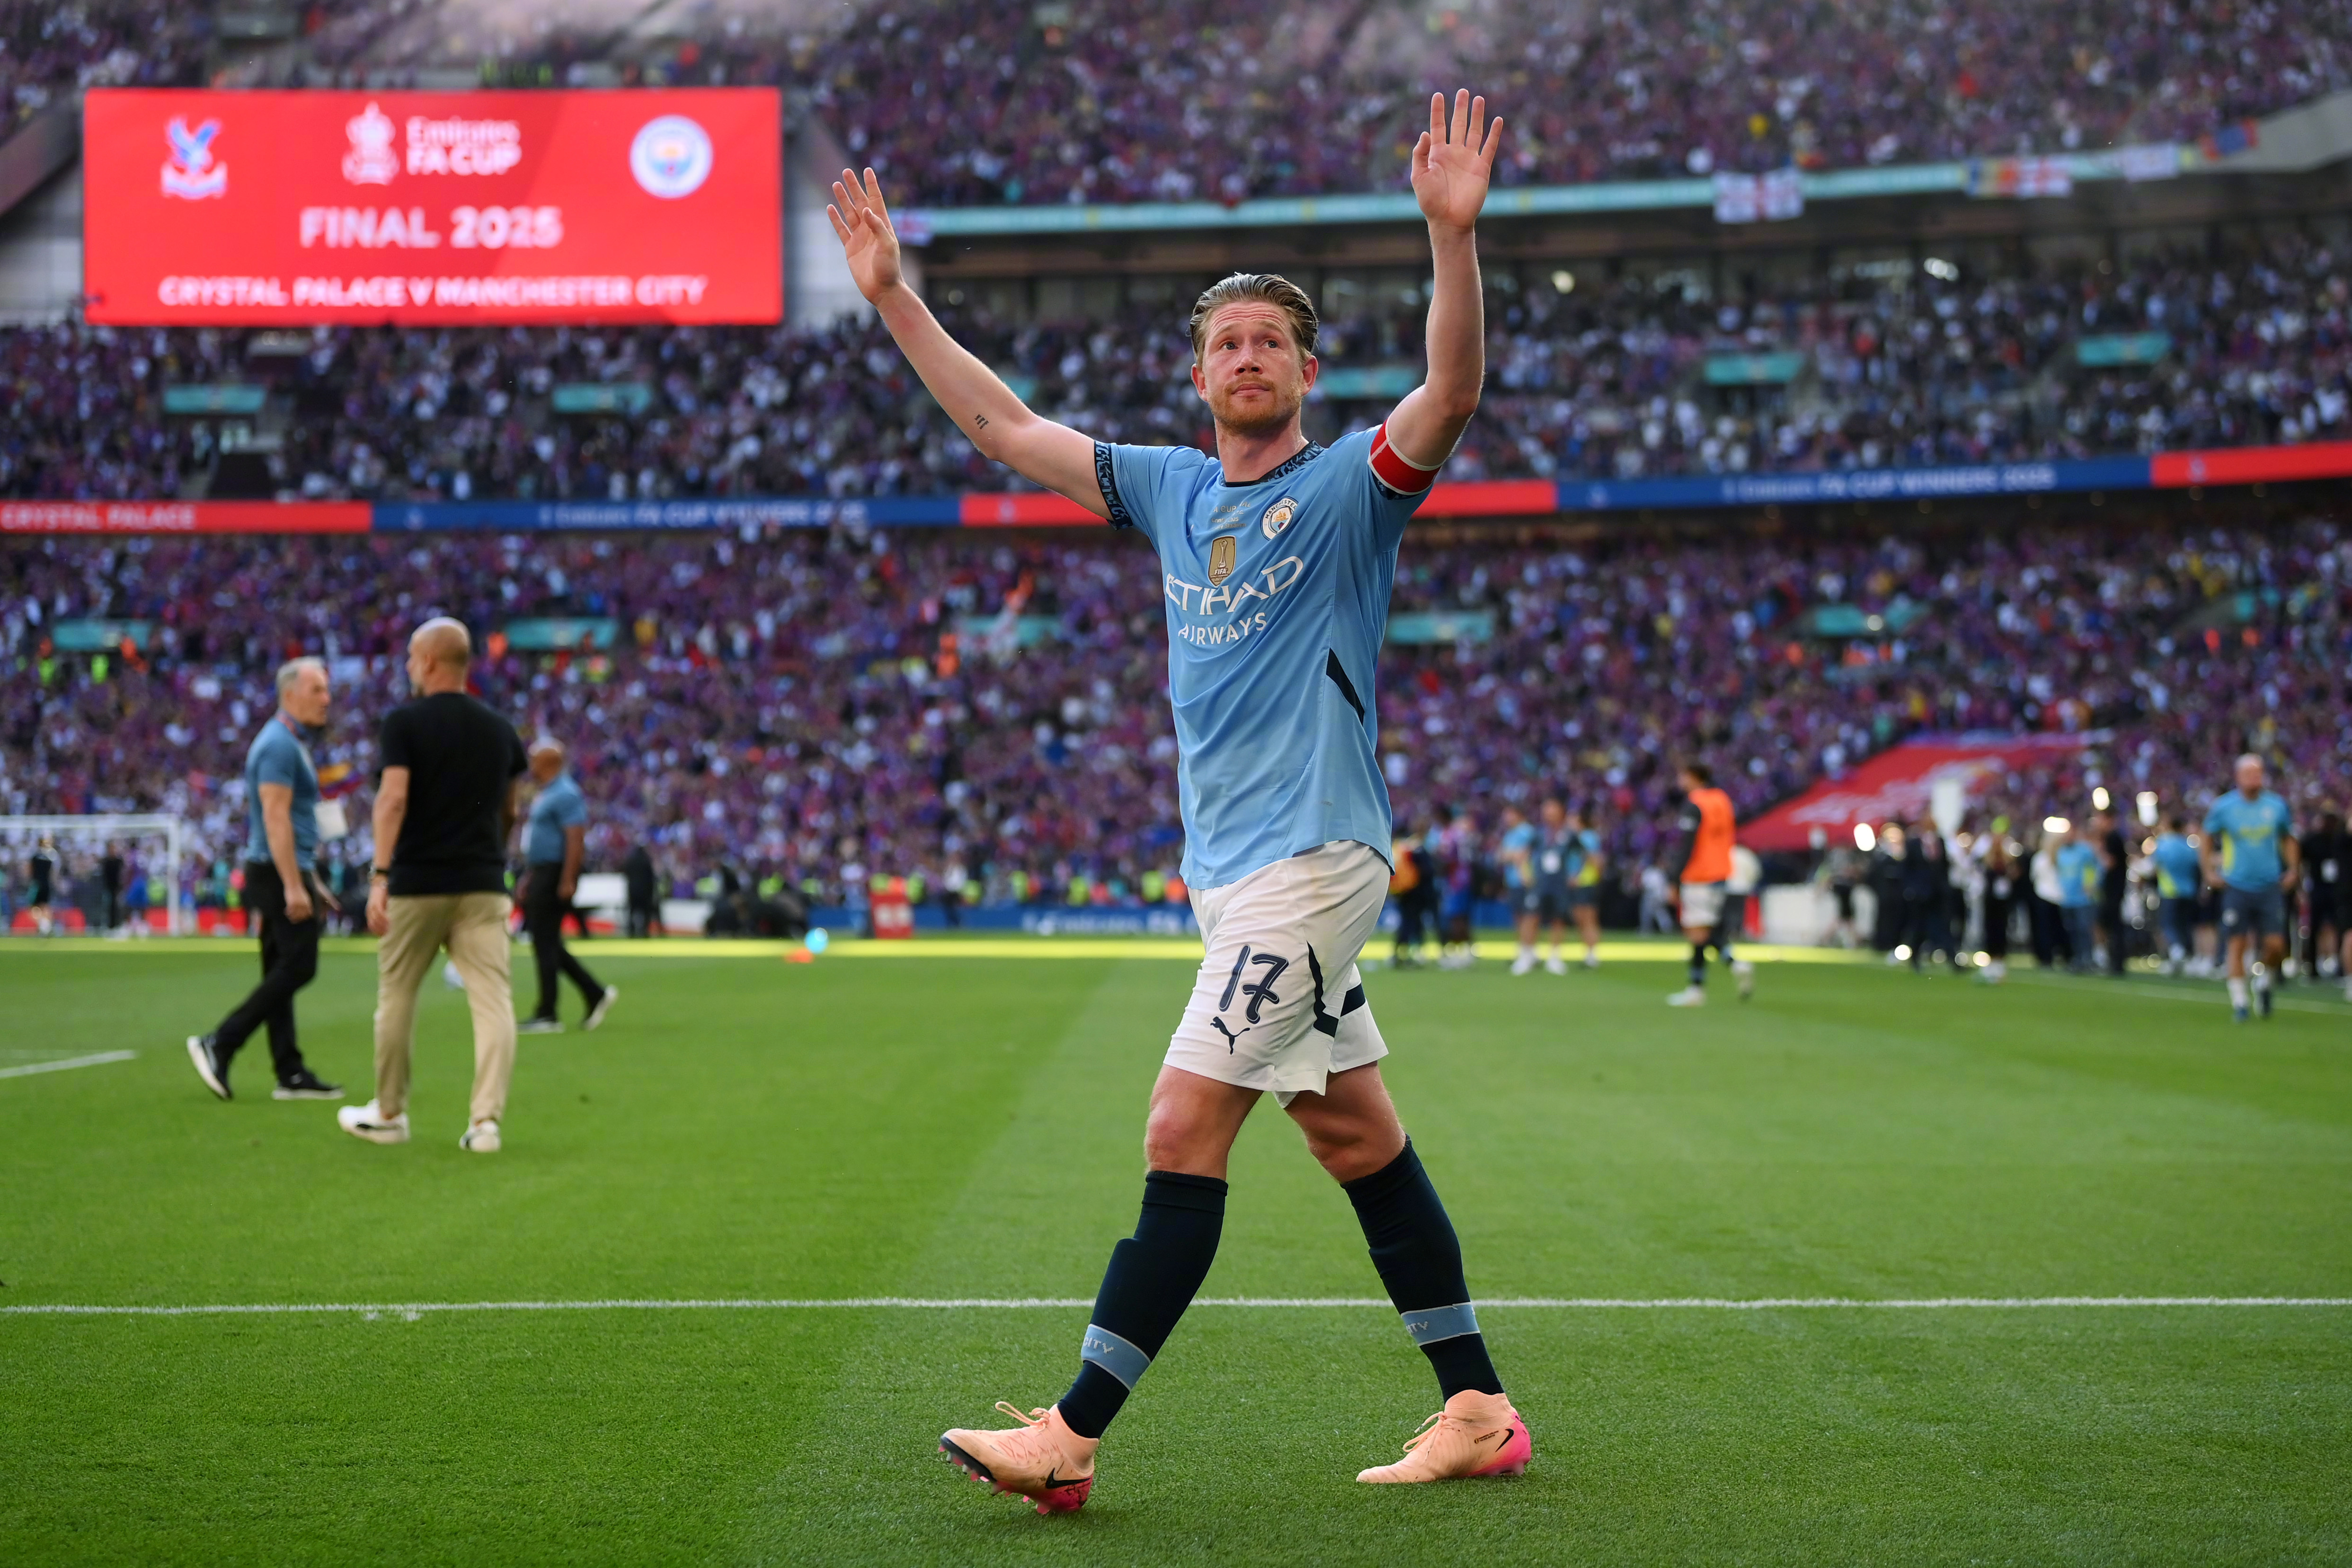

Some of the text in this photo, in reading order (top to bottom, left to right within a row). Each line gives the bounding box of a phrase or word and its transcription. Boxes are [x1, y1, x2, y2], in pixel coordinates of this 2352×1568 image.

[406, 116, 520, 143] Emirates
[406, 143, 521, 175] FA CUP
[300, 205, 564, 249] FINAL 2025
[158, 275, 708, 307] CRYSTAL PALACE V MANCHESTER CITY
[1847, 472, 1893, 498] CUP
[1, 504, 195, 529] CRYSTAL PALACE
[664, 502, 709, 527] CUP
[1165, 556, 1304, 615] ETIHAD
[1178, 612, 1267, 645] AIRWAYS
[1218, 944, 1289, 1024] 17
[1083, 1337, 1114, 1354] CITY
